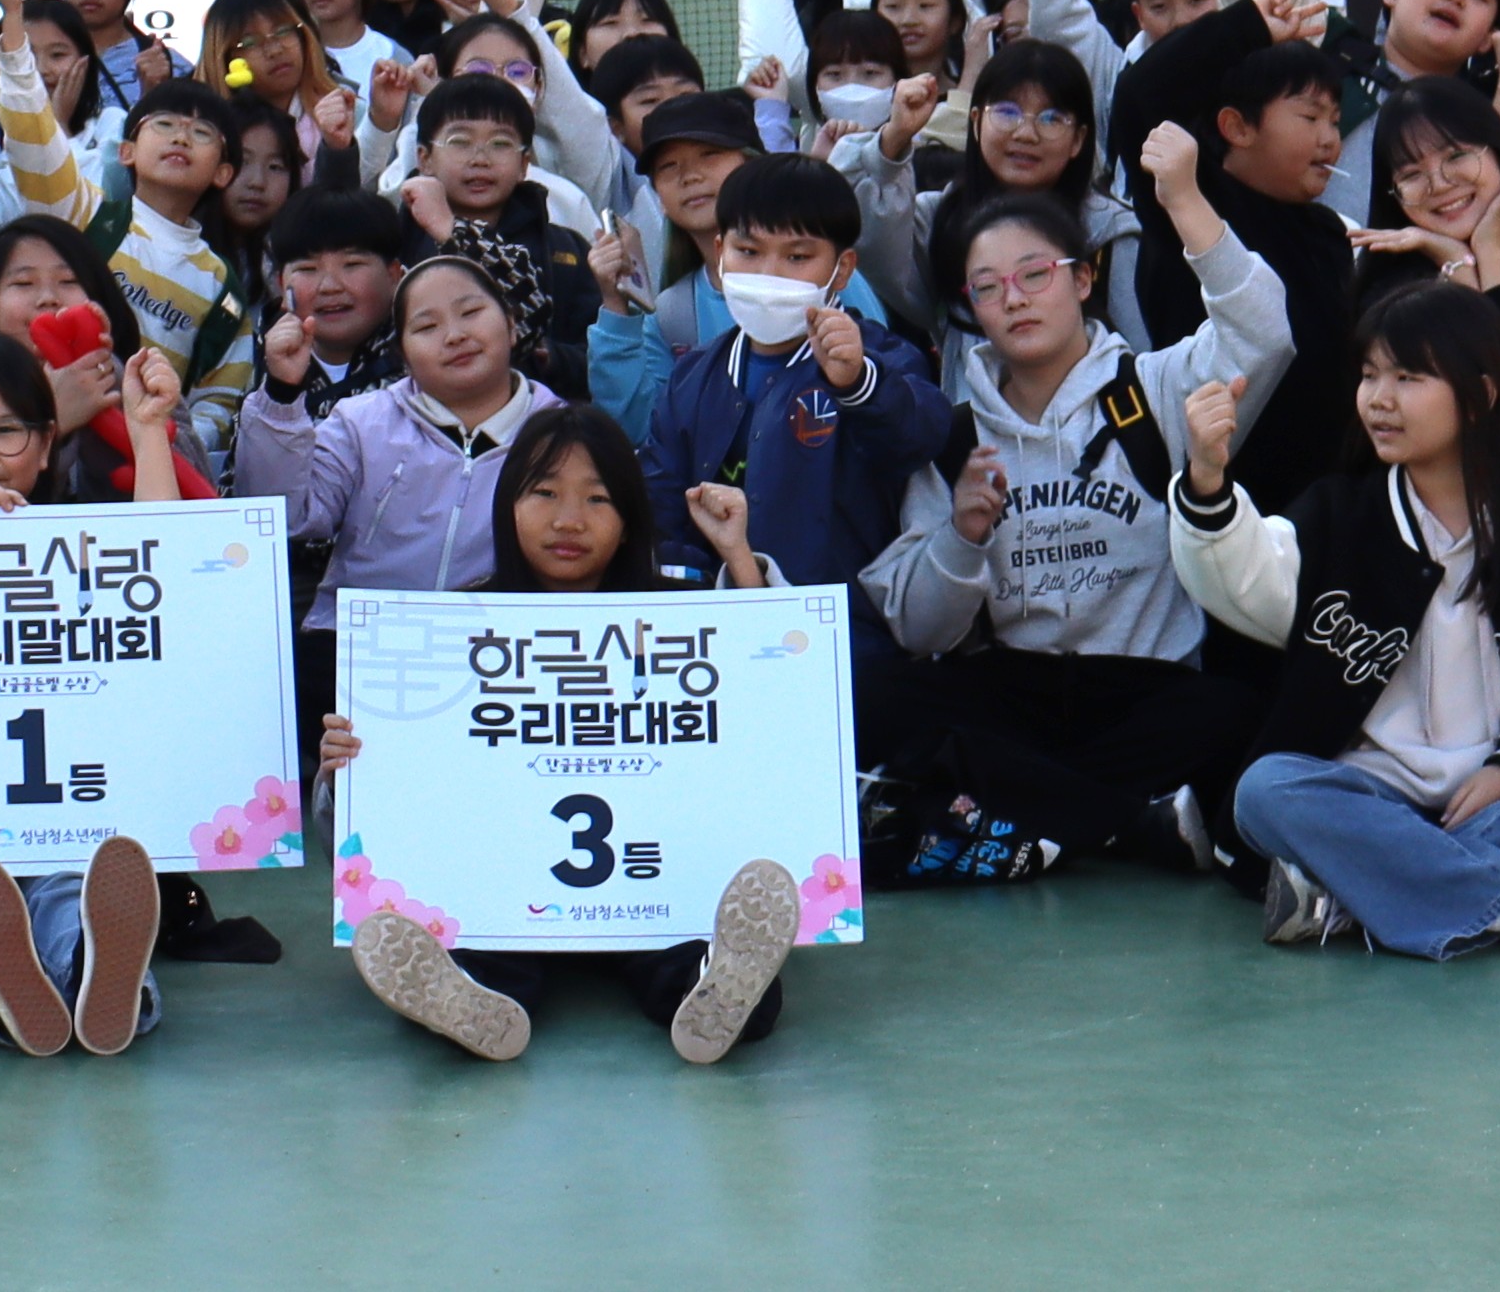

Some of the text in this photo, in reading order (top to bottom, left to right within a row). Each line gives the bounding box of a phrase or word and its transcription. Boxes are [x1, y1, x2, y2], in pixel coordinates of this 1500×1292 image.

[993, 479, 1142, 530] PENHAGEN
[468, 617, 720, 698] 한글사랑
[64, 675, 92, 691] 수상
[468, 699, 718, 747] 우리말대회
[6, 708, 107, 805] 1등
[545, 757, 645, 773] 한글골든벨 수상
[549, 793, 663, 889] 3등
[568, 903, 670, 921] 성남청소년센터
